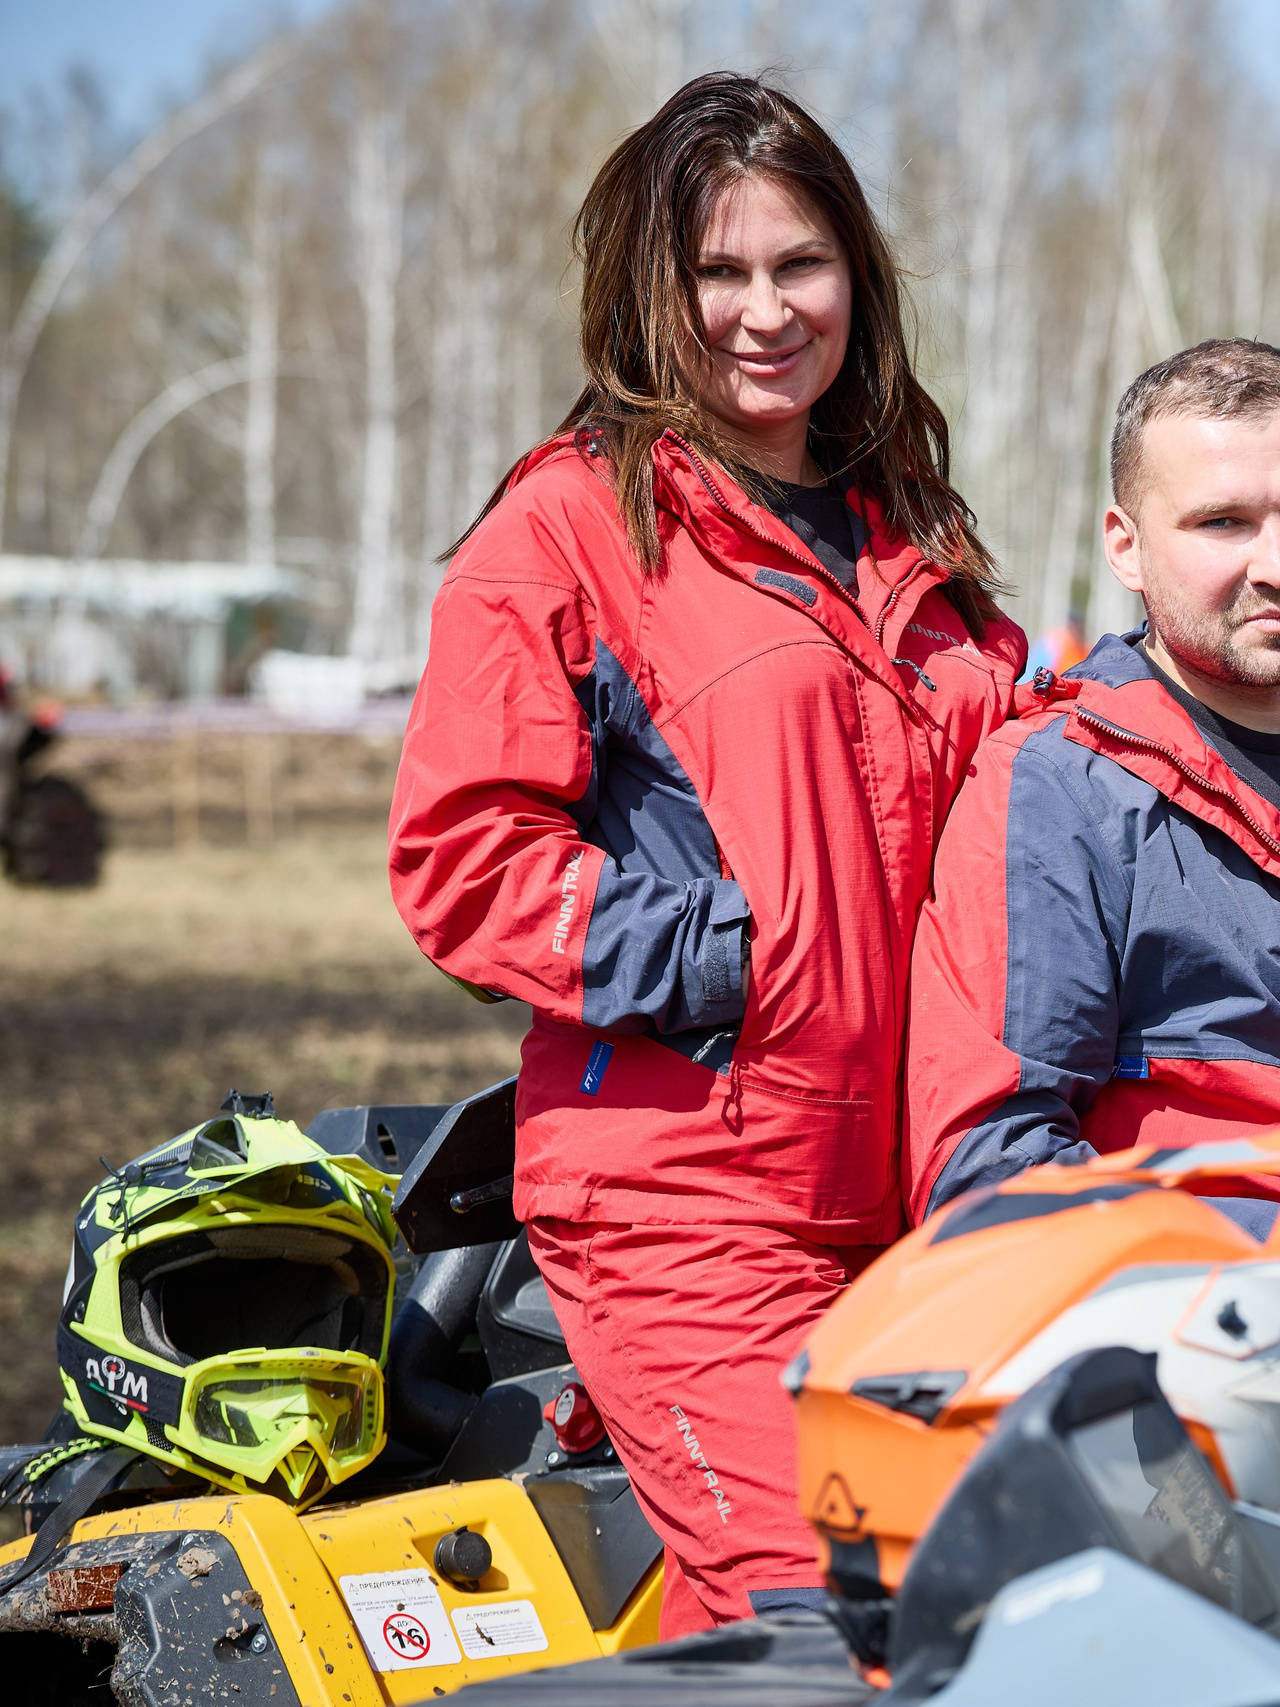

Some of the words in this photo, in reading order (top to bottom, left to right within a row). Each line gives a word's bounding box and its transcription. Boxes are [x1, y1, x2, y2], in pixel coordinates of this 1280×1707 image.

[669, 1404, 732, 1524] FINNTRAIL
[359, 1577, 425, 1590] ПРЕДУПРЕЖДЕНИЕ
[473, 1608, 521, 1619] ПРЕДУПРЕЖДЕНИЕ
[391, 1628, 425, 1649] 16
